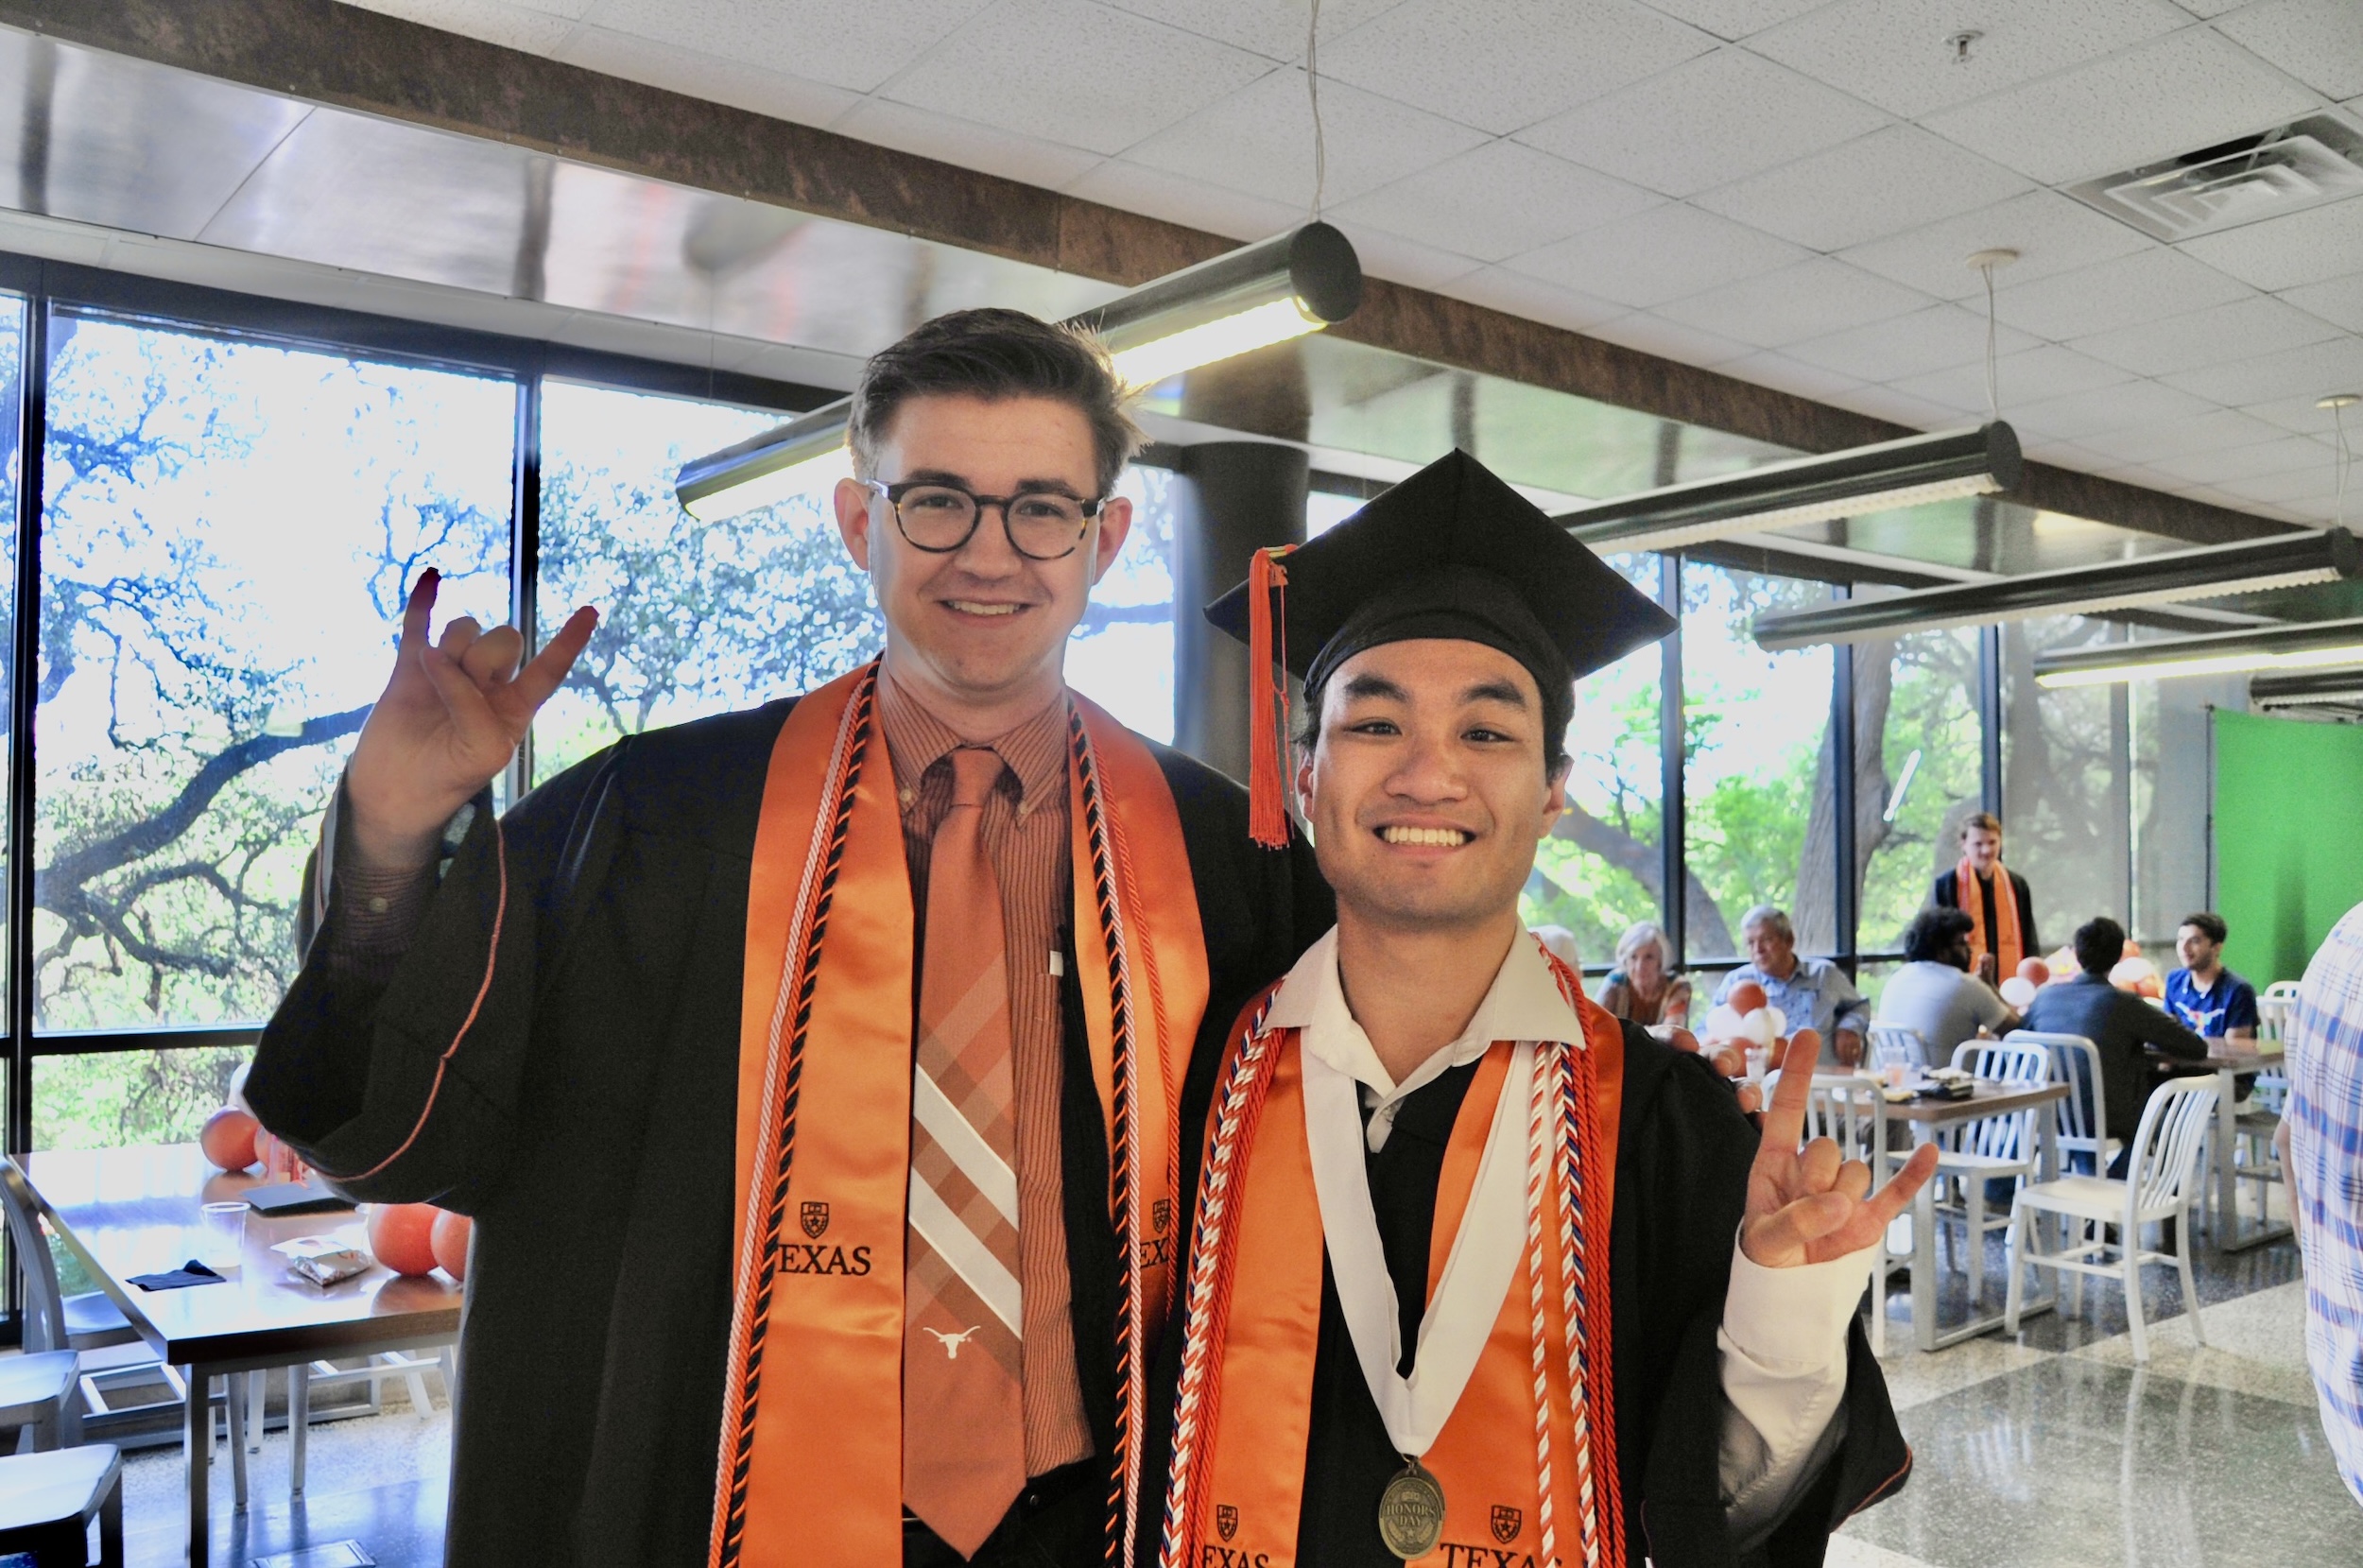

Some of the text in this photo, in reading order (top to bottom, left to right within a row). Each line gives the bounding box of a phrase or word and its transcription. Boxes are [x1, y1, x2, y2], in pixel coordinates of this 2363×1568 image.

[778, 1244, 871, 1276] EXAS
[1386, 1504, 1436, 1517] HONORS
[1399, 1515, 1422, 1526] DAY
[1203, 1544, 1269, 1568] EXAS
[1440, 1542, 1562, 1568] TEX
